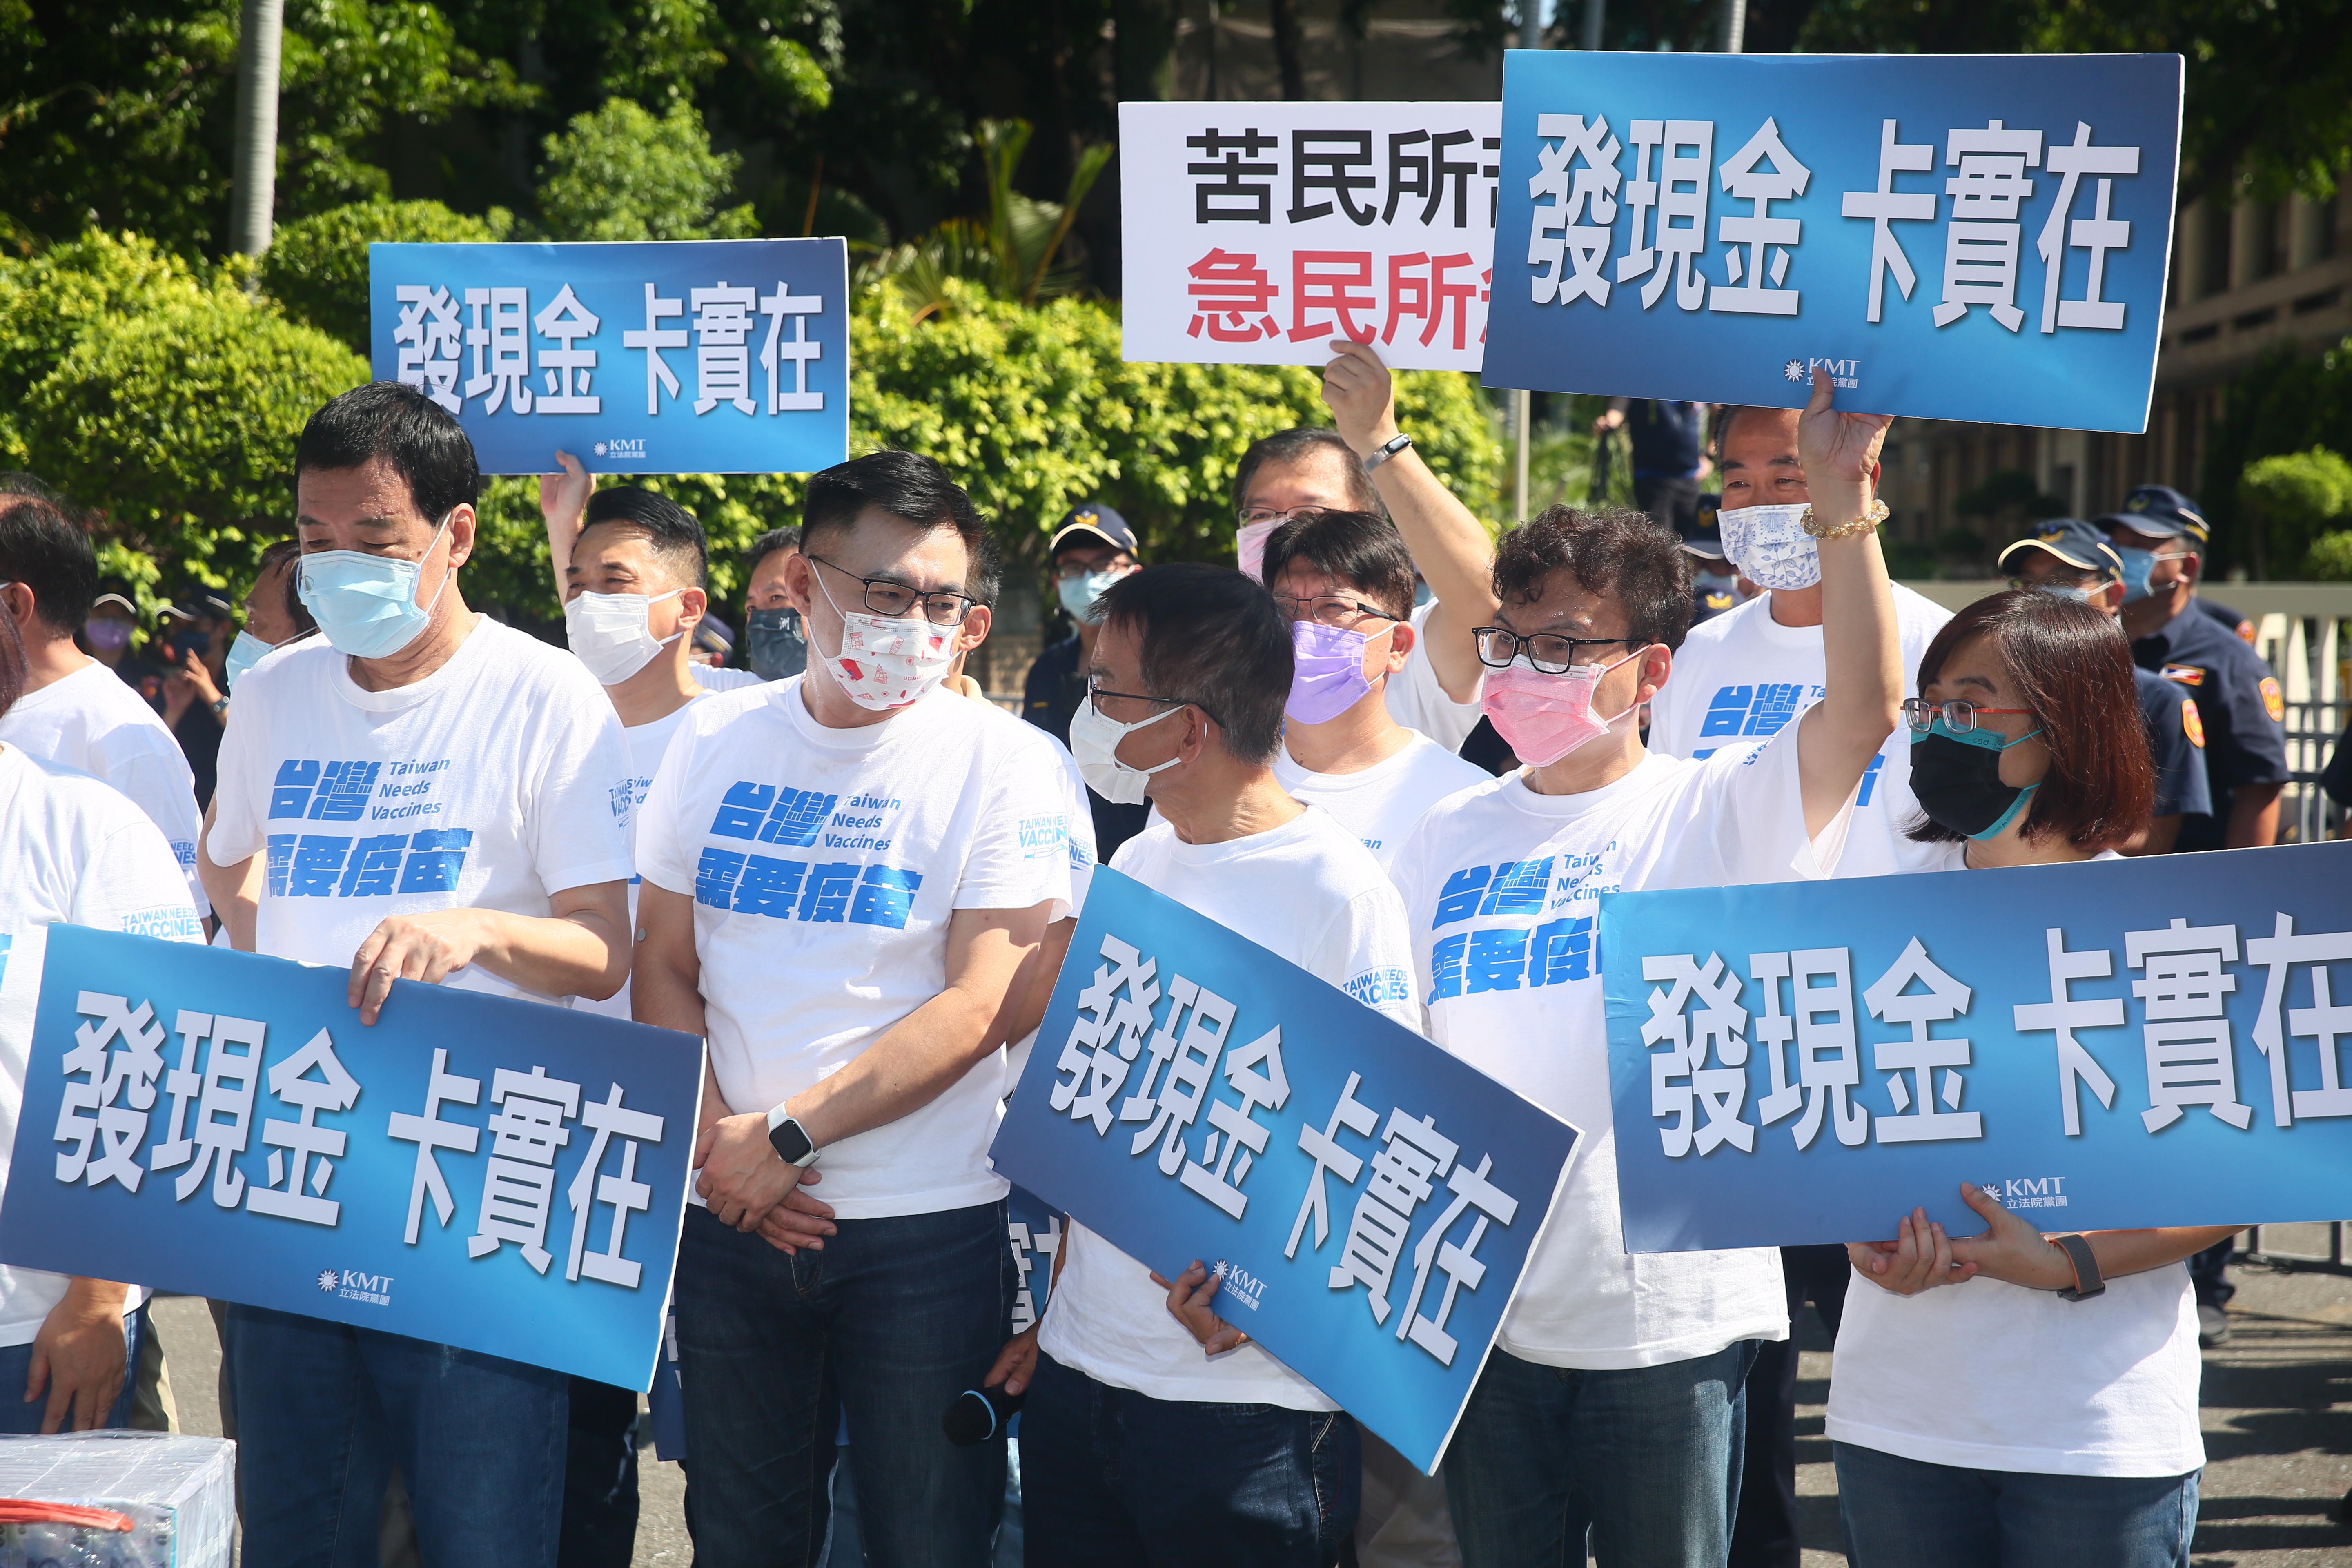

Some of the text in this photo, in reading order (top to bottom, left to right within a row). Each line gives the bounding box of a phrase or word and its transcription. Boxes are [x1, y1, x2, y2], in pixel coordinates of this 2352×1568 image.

[1186, 128, 1501, 228] 苦民所
[1529, 113, 2140, 333] 發現金 卡實在
[1186, 247, 1492, 350] 急民所
[393, 280, 824, 415] 發現金 卡實在
[1809, 358, 1860, 376] KMT
[1806, 375, 1858, 388] 立黨團
[610, 439, 646, 451] KMT
[1699, 683, 1804, 737] 台灣
[390, 759, 450, 775] Taiwan
[268, 760, 382, 821] 台灣
[379, 780, 431, 798] Needs
[371, 801, 442, 820] Vaccines
[844, 793, 901, 810] Taiwan
[710, 781, 838, 848] 台灣
[831, 813, 882, 828] Needs
[1019, 817, 1051, 831] TAIWAN
[172, 842, 194, 851] NEED
[826, 834, 891, 850] Vaccines
[1018, 826, 1067, 848] VACCIN
[267, 828, 474, 897] 需要疫苗
[695, 847, 924, 929] 需要疫苗
[1432, 855, 1556, 931] 台灣
[122, 907, 198, 926] TAIWAN NEEDS
[1427, 915, 1602, 1006] 需要疫
[1343, 971, 1382, 992] TAIWA
[1640, 911, 2352, 1157] 發現金 卡實在
[53, 990, 664, 1288] 發現金 卡實在
[1049, 933, 1291, 1220] 發現金
[1284, 1071, 1519, 1366] 卡實在
[2005, 1176, 2065, 1196] KMT
[2006, 1196, 2067, 1209] 立法院黨團
[342, 1270, 394, 1293] KMT
[1229, 1264, 1267, 1298] KMT
[339, 1287, 390, 1306] 立法院黨團
[1224, 1281, 1260, 1311] 立法院黨團
